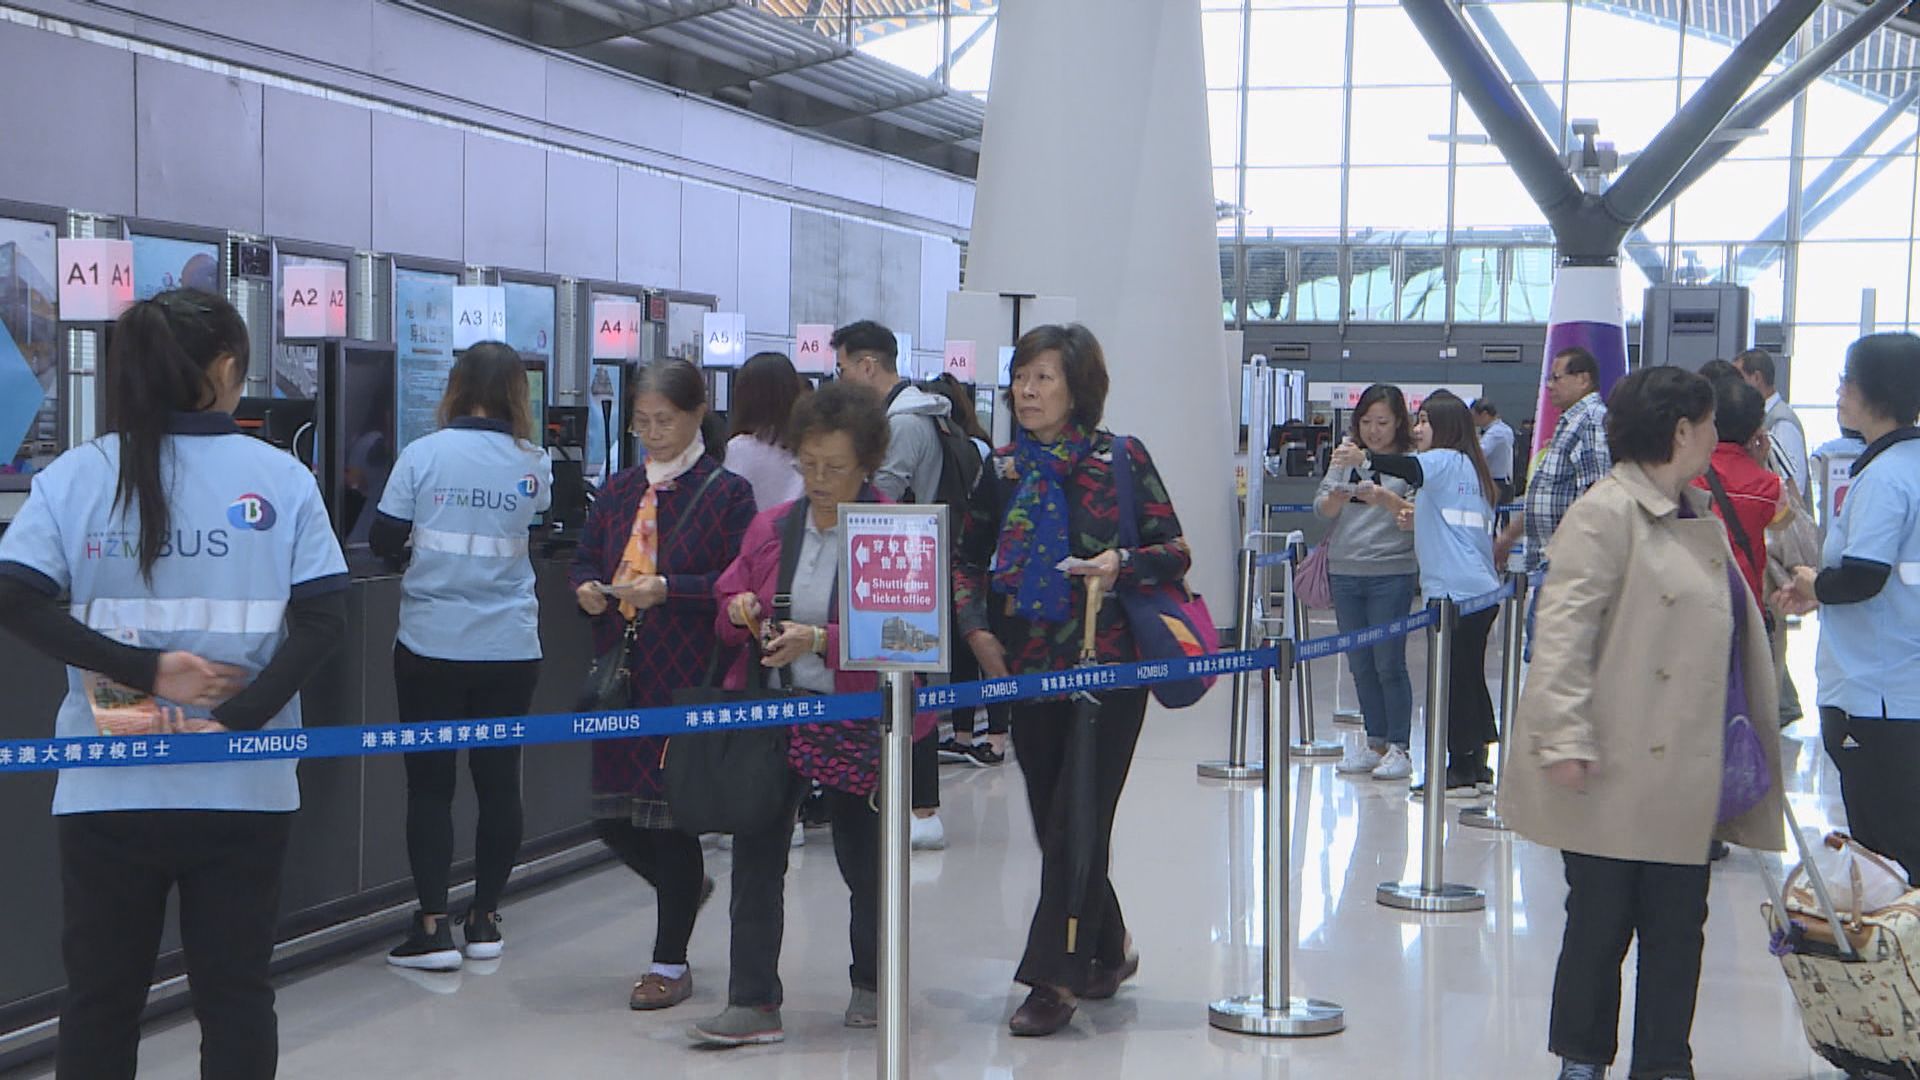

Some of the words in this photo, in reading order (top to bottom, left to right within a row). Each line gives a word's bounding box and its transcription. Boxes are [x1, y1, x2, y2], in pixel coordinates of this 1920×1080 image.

[67, 262, 98, 285] A1
[111, 264, 131, 287] A1
[291, 288, 318, 307] A2
[329, 289, 344, 307] A2
[459, 310, 482, 326] A3
[492, 311, 503, 327] A3
[600, 319, 621, 333] A4
[709, 331, 729, 344] A5
[801, 341, 819, 352] A6
[950, 356, 966, 367] A8
[911, 578, 929, 590] bus
[872, 592, 901, 604] ticket
[902, 592, 931, 606] office
[981, 680, 1018, 699] HZMBUS
[1137, 663, 1169, 680] HZMBUS
[229, 733, 308, 754] HZMBUS
[362, 722, 525, 748] 港珠澳大橋穿梭巴士
[573, 713, 640, 734] HZMBUS
[686, 699, 825, 727] 港珠澳大橋穿梭巴士
